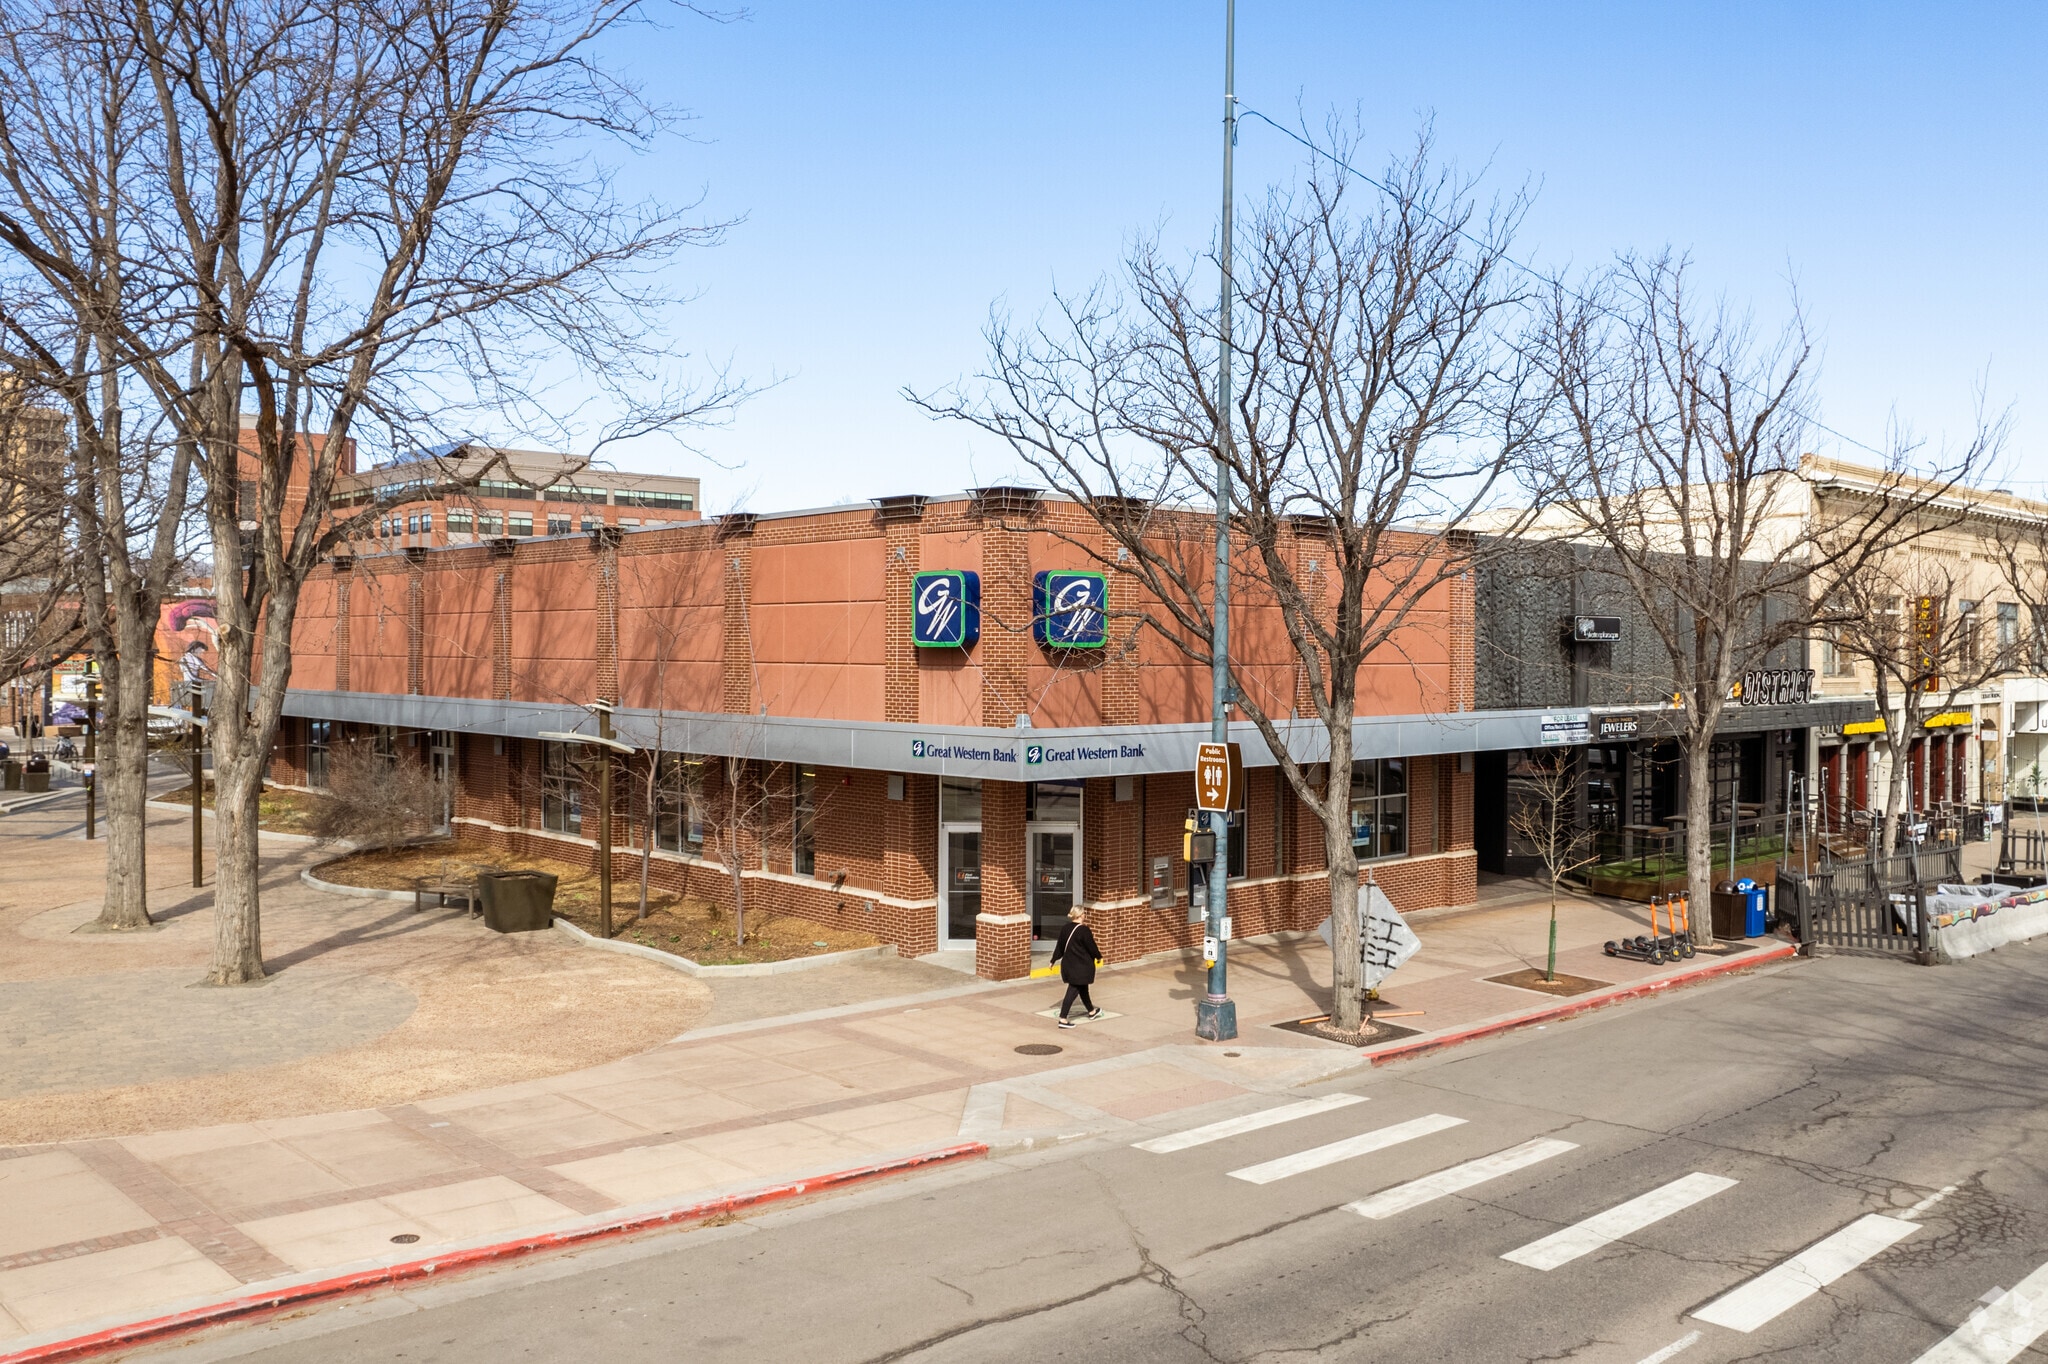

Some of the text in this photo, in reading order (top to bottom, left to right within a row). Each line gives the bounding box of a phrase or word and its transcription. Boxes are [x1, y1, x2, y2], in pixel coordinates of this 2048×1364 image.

[1742, 670, 1815, 705] DISTRICT
[1600, 722, 1638, 735] JEWELERS
[926, 744, 1017, 763] Great Western Bank
[1045, 744, 1145, 762] Great Western Bank
[1205, 747, 1221, 755] Public
[1200, 755, 1226, 763] Restrooms
